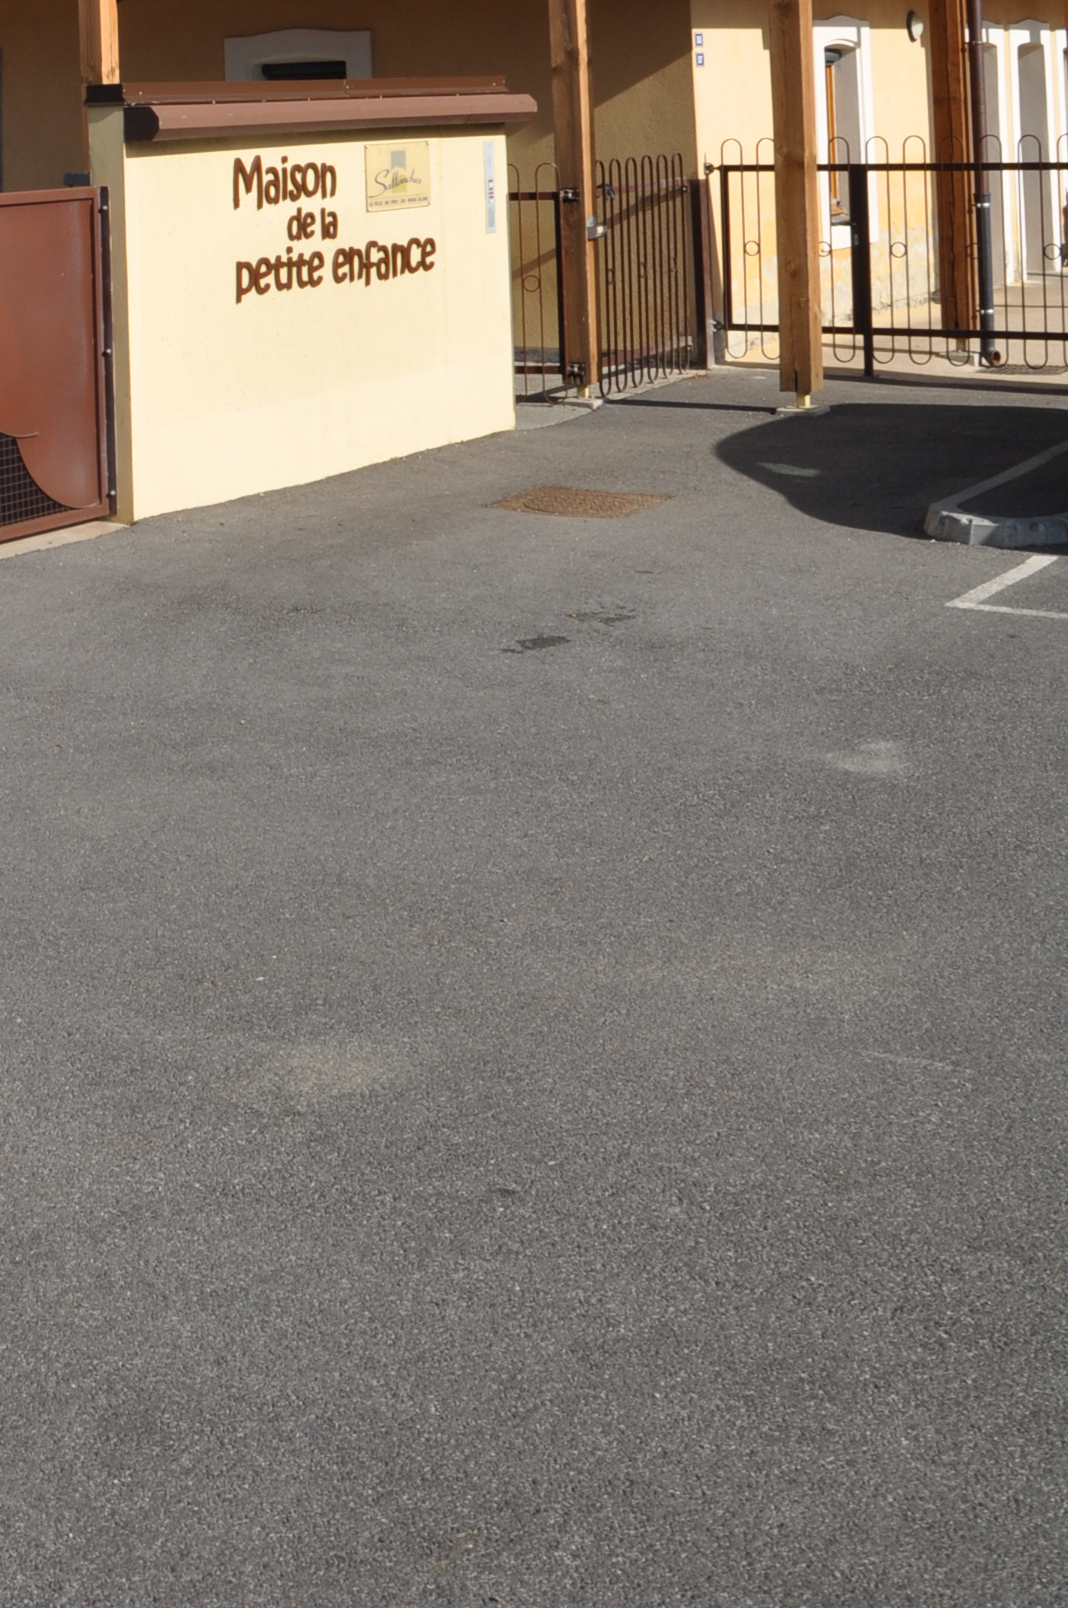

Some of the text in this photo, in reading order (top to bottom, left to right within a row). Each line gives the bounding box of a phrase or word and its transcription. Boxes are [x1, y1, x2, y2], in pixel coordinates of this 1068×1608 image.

[233, 154, 338, 211] Maison
[287, 207, 339, 242] de la
[235, 237, 437, 305] petite enfance
